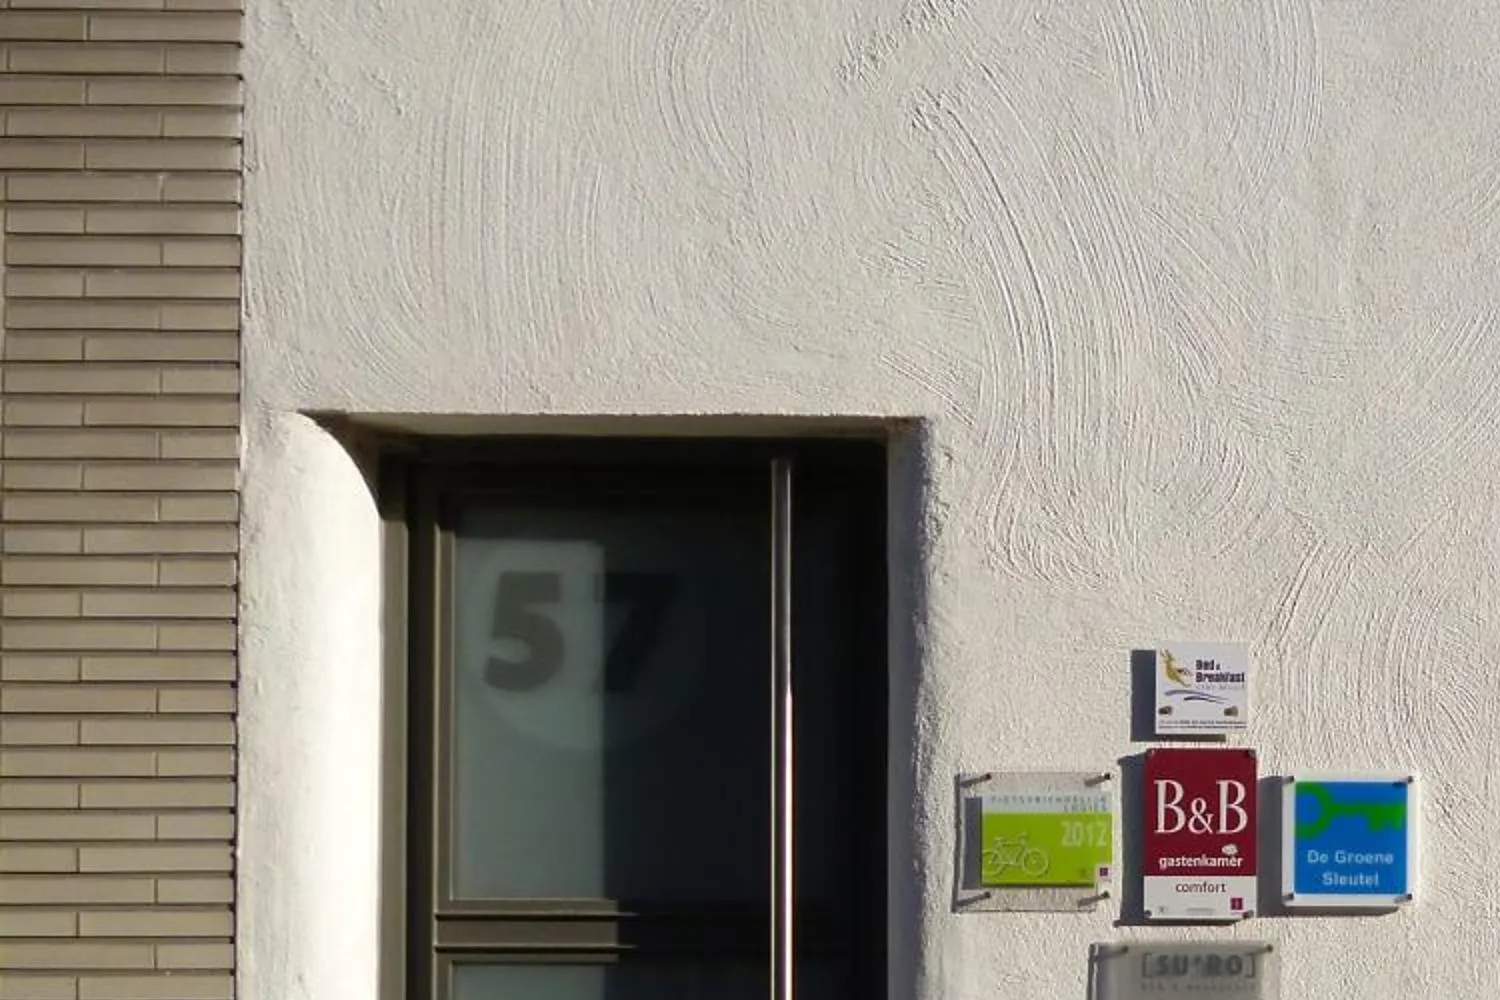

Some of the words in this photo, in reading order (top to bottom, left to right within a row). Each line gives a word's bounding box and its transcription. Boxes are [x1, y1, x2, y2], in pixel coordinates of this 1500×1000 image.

[482, 570, 678, 694] 57
[1195, 659, 1215, 670] Bed
[1195, 671, 1245, 682] Breakfast
[1153, 779, 1249, 835] B&B
[1060, 820, 1108, 848] 2012
[1158, 853, 1244, 871] gastenkamer
[1306, 849, 1329, 864] De
[1334, 849, 1395, 865] Groene
[1175, 881, 1227, 893] comfort
[1321, 871, 1380, 887] Sleutel
